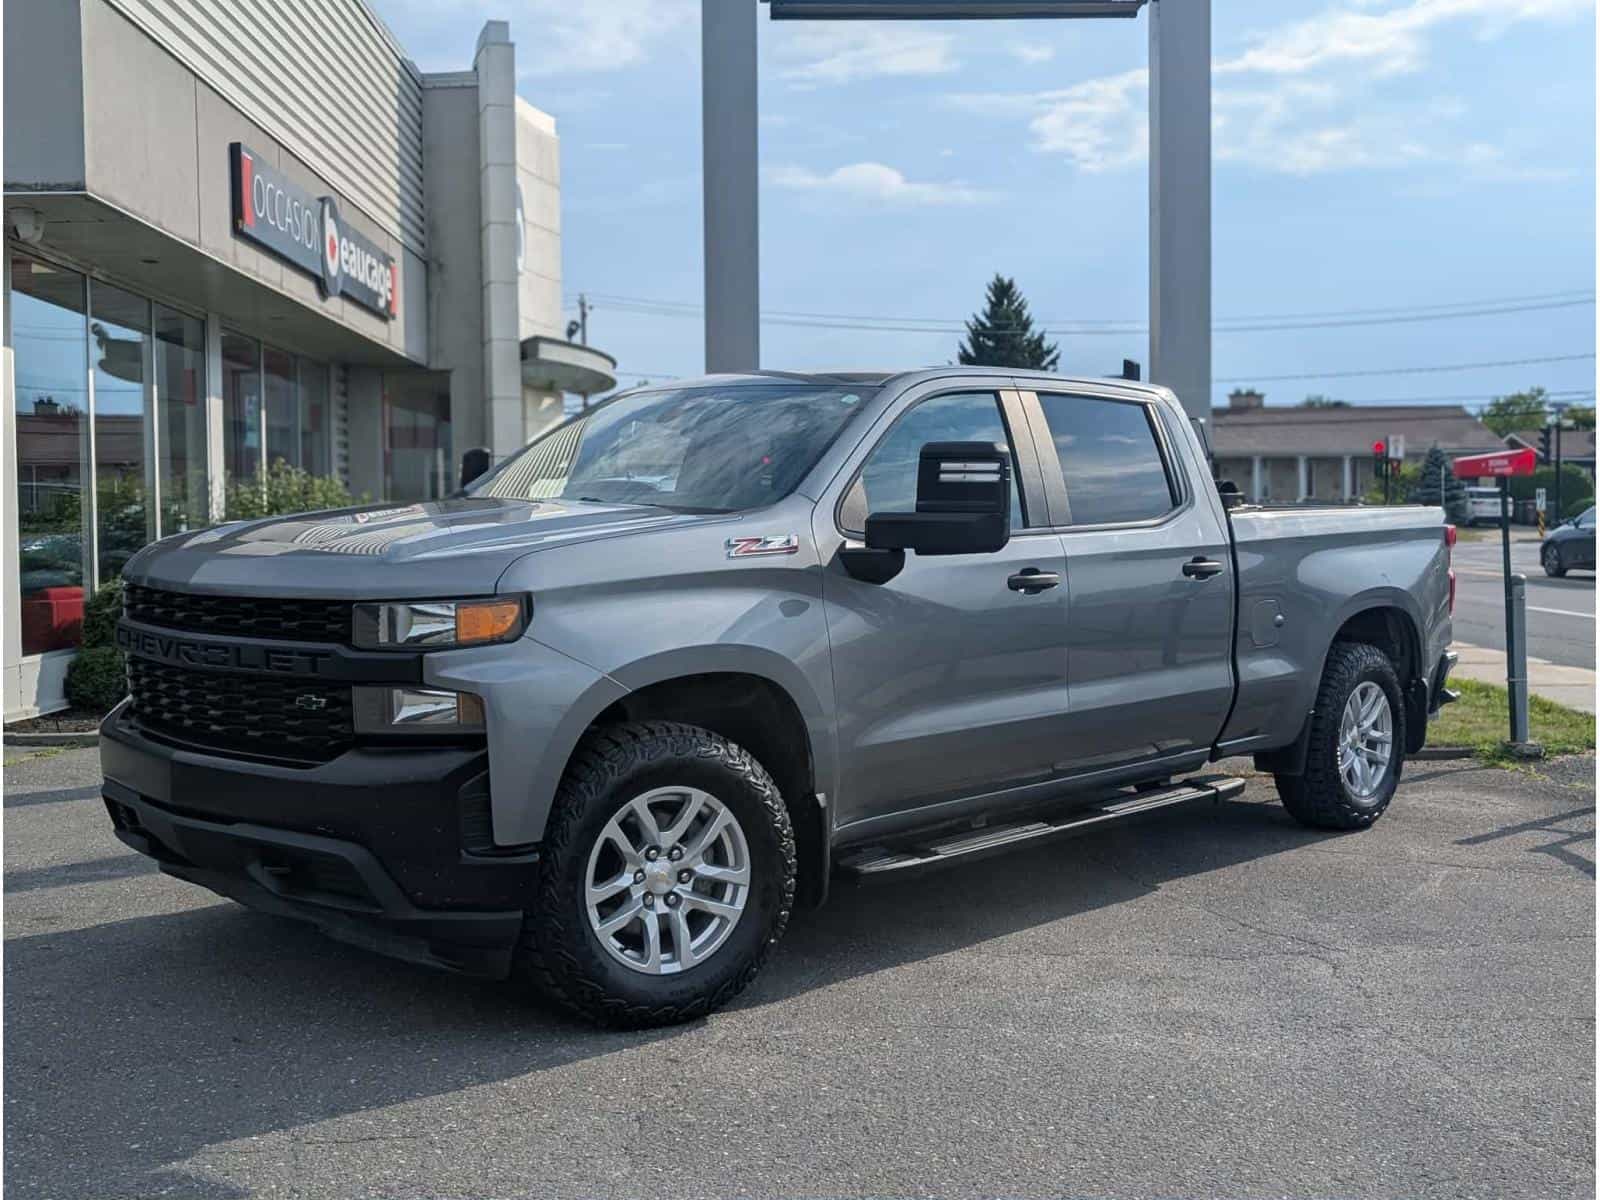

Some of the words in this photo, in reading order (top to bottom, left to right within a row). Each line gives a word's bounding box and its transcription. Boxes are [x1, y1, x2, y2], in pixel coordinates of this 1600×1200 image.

[324, 203, 392, 308] beaucage
[725, 533, 799, 559] Z71
[117, 625, 334, 673] CHEVROLET
